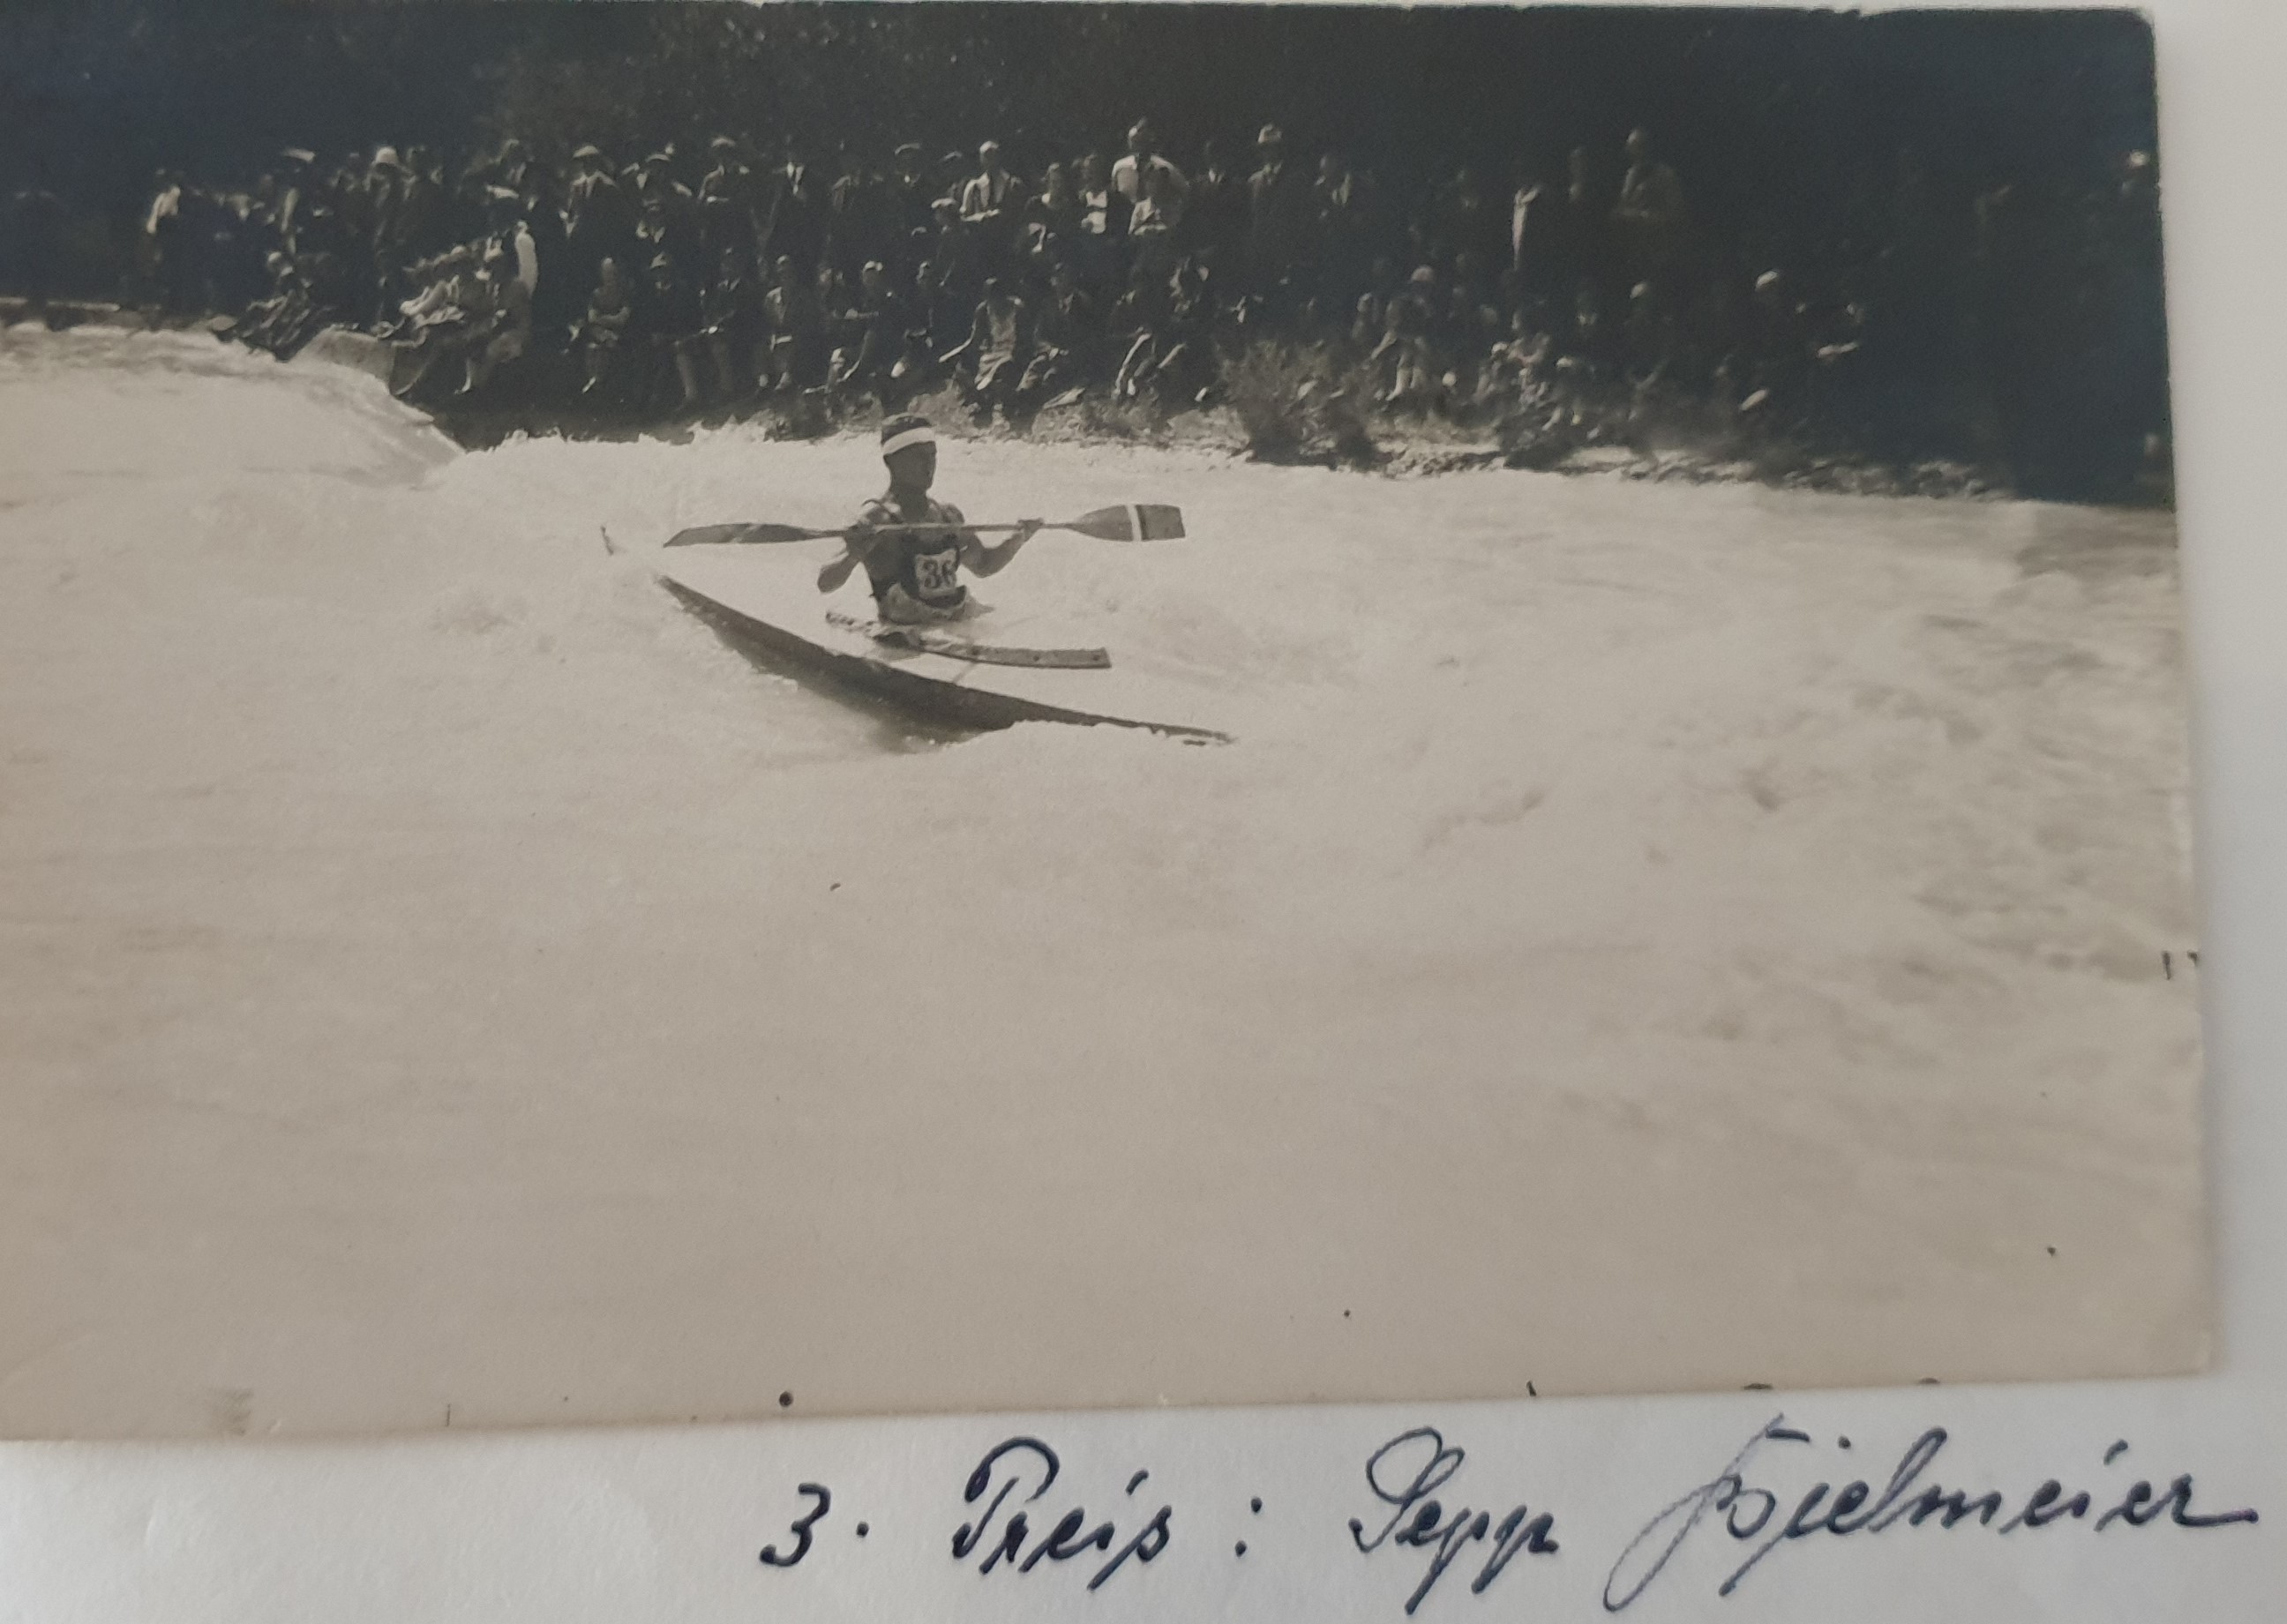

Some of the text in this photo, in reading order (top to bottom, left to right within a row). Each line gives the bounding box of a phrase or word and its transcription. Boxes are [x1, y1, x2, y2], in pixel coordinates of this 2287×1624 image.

[922, 558, 956, 589] 36
[760, 1482, 869, 1567] 3.
[1348, 1427, 1559, 1615] Sepp
